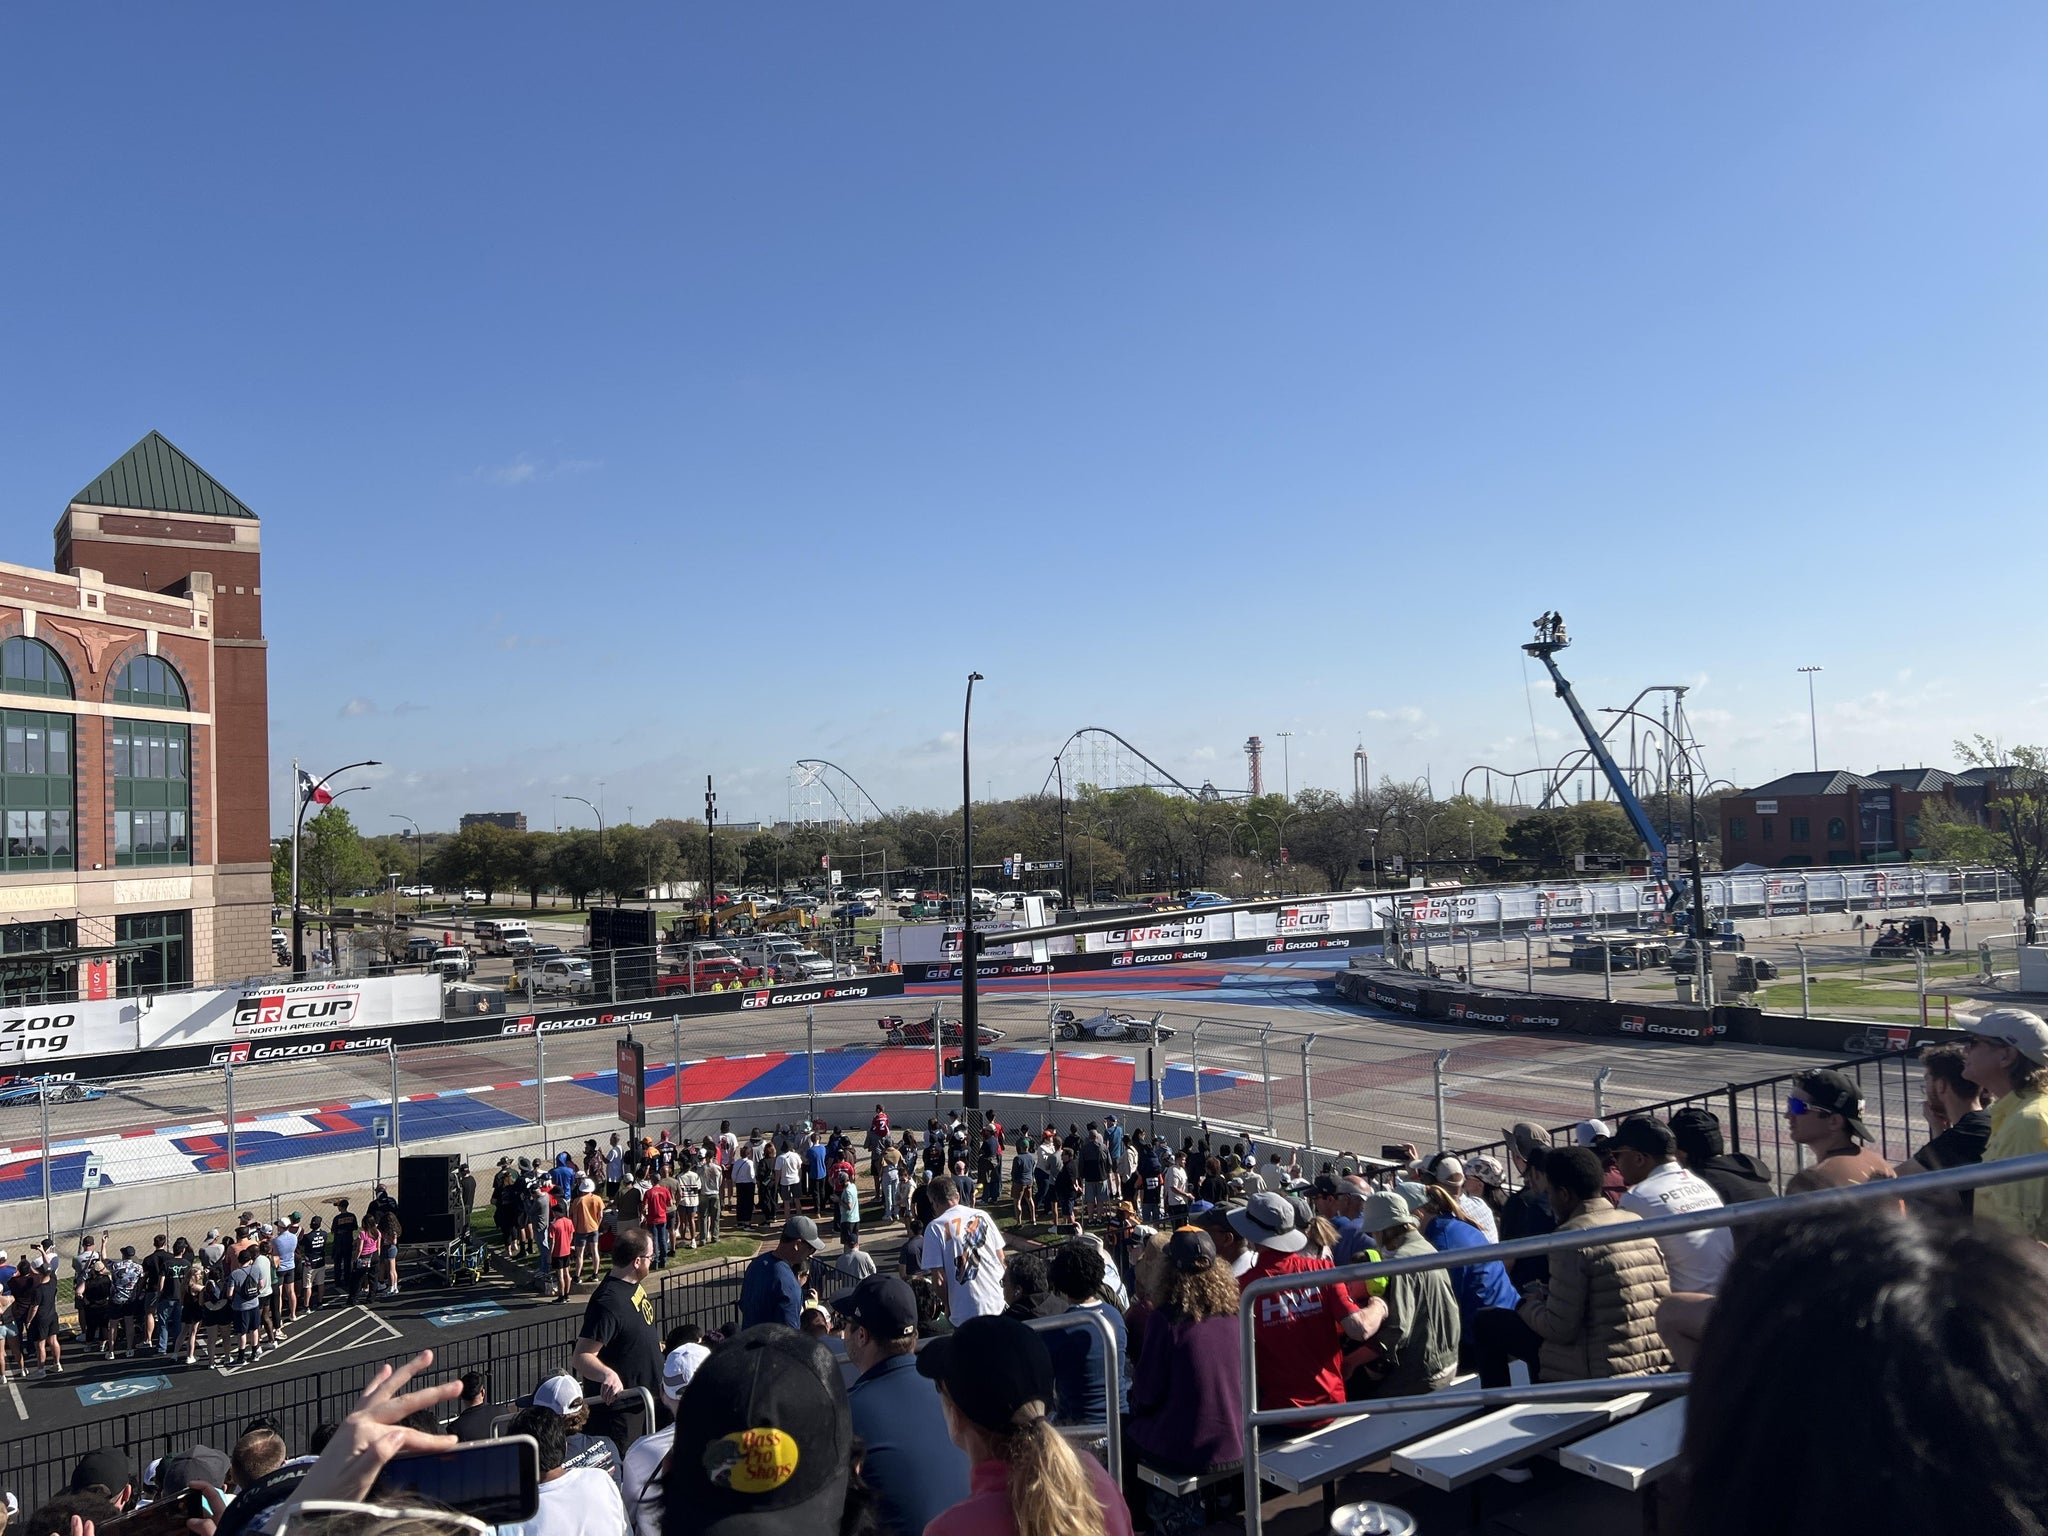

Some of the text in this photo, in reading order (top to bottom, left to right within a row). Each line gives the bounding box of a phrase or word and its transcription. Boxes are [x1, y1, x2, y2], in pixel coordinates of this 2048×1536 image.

[1431, 897, 1476, 907] GAZOO
[1557, 898, 1582, 907] CUP
[1277, 913, 1330, 927] GR CUP
[1109, 927, 1202, 941] GR Racing
[1267, 938, 1349, 952] GR GAZOO Racing
[1113, 949, 1207, 965] GR GAZOO Racing
[93, 972, 101, 983] S
[926, 964, 1042, 978] GR GZOO Racing
[241, 988, 284, 997] TOYOTA
[286, 985, 325, 994] GAZOO
[743, 987, 868, 1007] GR GAZOO Racing
[236, 1000, 353, 1024] GR CUP
[1449, 1008, 1559, 1026] GR GAZOO Racing
[250, 1021, 338, 1034] NORTH AMERICA
[502, 1012, 652, 1034] GR GAZOO Racing
[884, 1020, 891, 1028] 12
[1621, 1022, 1643, 1031] GR
[1647, 1024, 1699, 1037] GAZOO
[212, 1037, 392, 1063] GR GAZOO Racing
[622, 1084, 630, 1094] LOT
[880, 1121, 885, 1130] 2
[944, 1217, 962, 1241] 17
[743, 1432, 781, 1449] Bass
[745, 1450, 773, 1465] Pro
[746, 1463, 792, 1482] Shops
